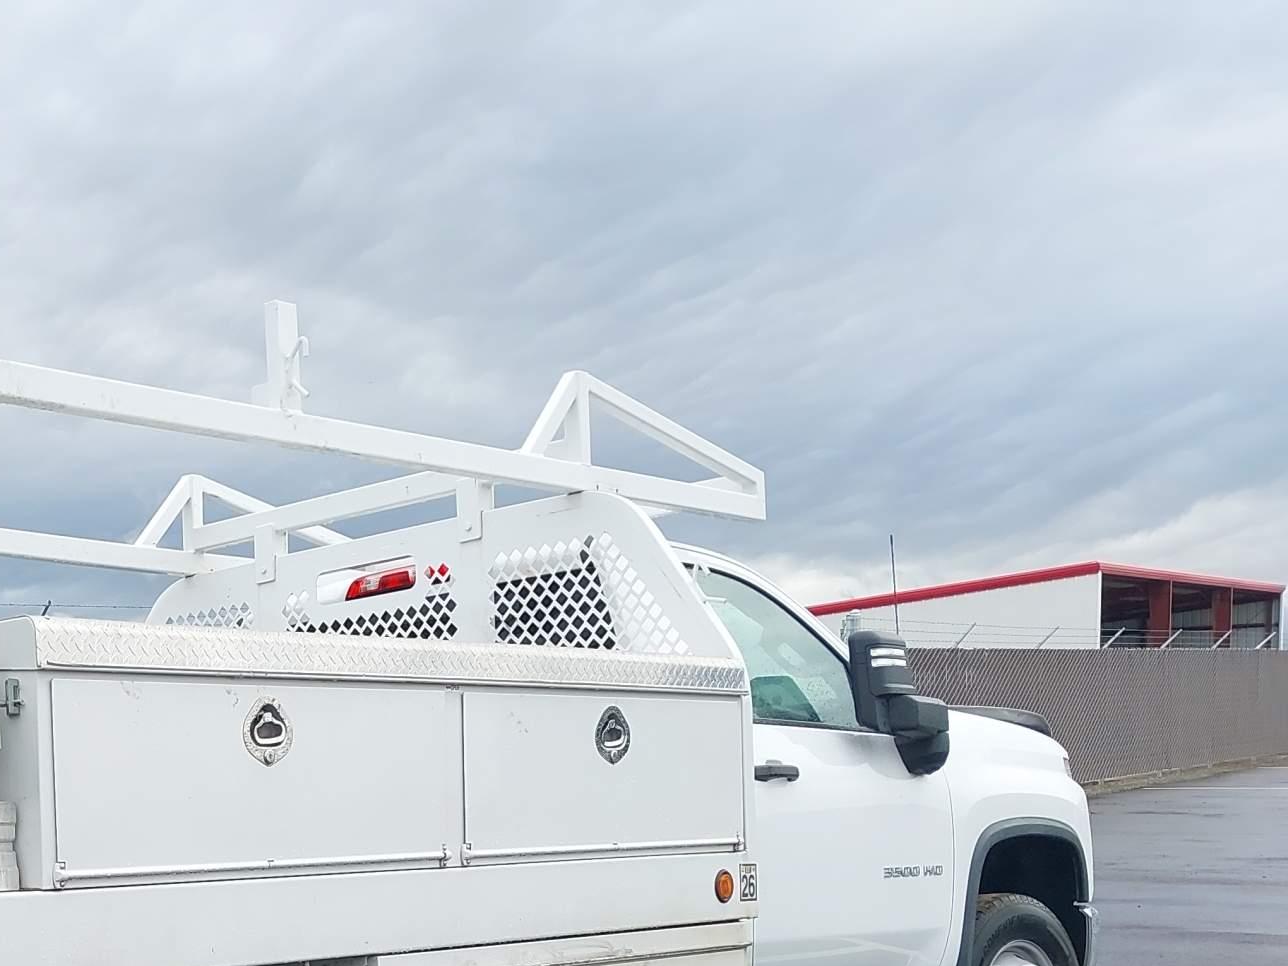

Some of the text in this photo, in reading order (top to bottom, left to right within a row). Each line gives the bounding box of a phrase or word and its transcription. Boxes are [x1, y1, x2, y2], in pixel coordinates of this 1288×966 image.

[883, 865, 944, 878] 3500 HD
[742, 874, 755, 898] 26
